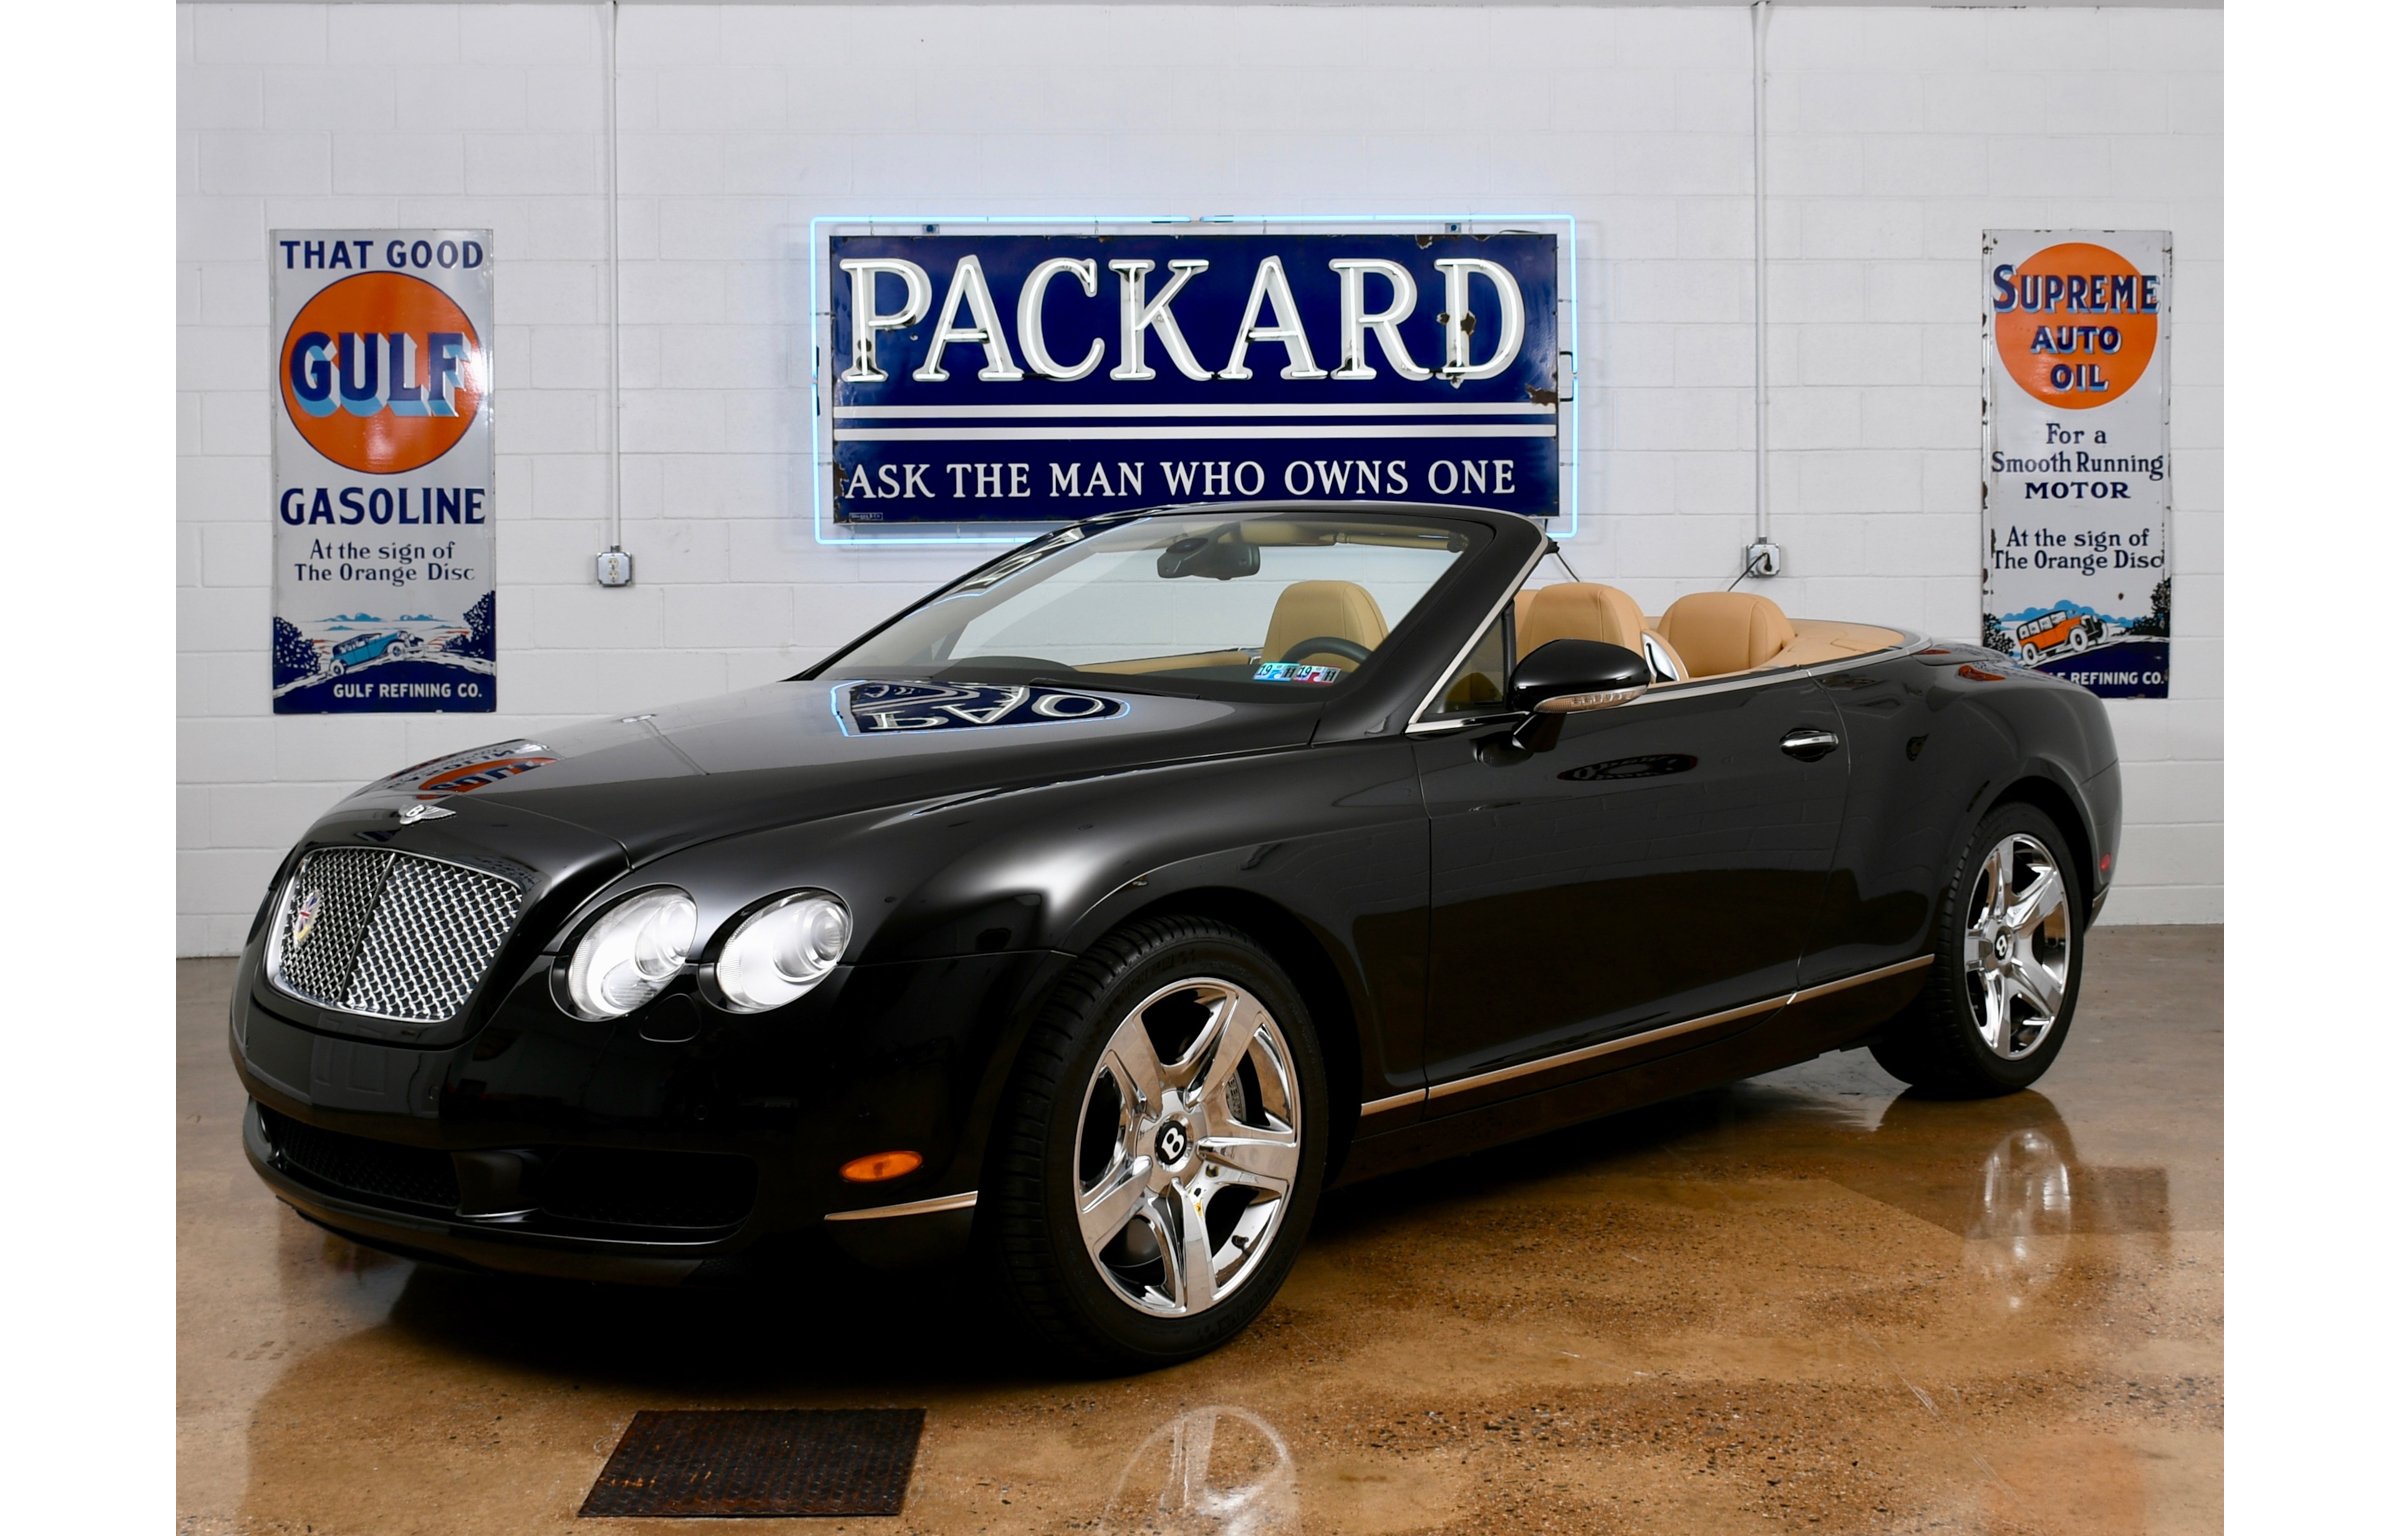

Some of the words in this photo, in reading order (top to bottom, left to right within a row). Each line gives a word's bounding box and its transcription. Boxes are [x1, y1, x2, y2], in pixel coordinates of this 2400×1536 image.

[280, 240, 374, 269] THAT
[386, 239, 484, 269] GOOD
[1992, 264, 2161, 313] SUPREME
[840, 254, 1526, 382] PACKARD
[2030, 325, 2122, 354] AUTO
[290, 331, 471, 417] GULF
[2050, 363, 2109, 392] OIL
[2046, 423, 2085, 444] For
[2094, 430, 2107, 444] a
[844, 463, 936, 499] ASK
[946, 463, 1031, 497] THE
[1049, 461, 1145, 497] MAN
[1160, 460, 1265, 496] WHO
[1284, 460, 1409, 495] OWNS
[1428, 459, 1516, 495] ONE
[1991, 450, 2072, 473] Smooth
[2076, 451, 2164, 481] Running
[2025, 481, 2131, 499] MOTOR
[280, 487, 487, 526] GASOLINE
[310, 538, 332, 560] At
[339, 541, 371, 560] the
[378, 542, 425, 564] sign
[432, 541, 456, 560] of
[2006, 525, 2029, 547] At
[2034, 528, 2067, 547] the
[2073, 529, 2121, 552] sign
[2128, 528, 2150, 547] of
[294, 563, 332, 581] The
[340, 563, 417, 587] Orange
[428, 562, 476, 581] Disc
[1993, 550, 2028, 569] The
[2034, 550, 2108, 576] Orange
[2114, 550, 2163, 569] Disc
[333, 683, 374, 698] GULF
[379, 683, 451, 698] REFINING
[457, 683, 483, 698] CO.
[2070, 671, 2138, 685] REFINING
[2142, 671, 2165, 685] CO.
[1161, 1126, 1185, 1160] B
